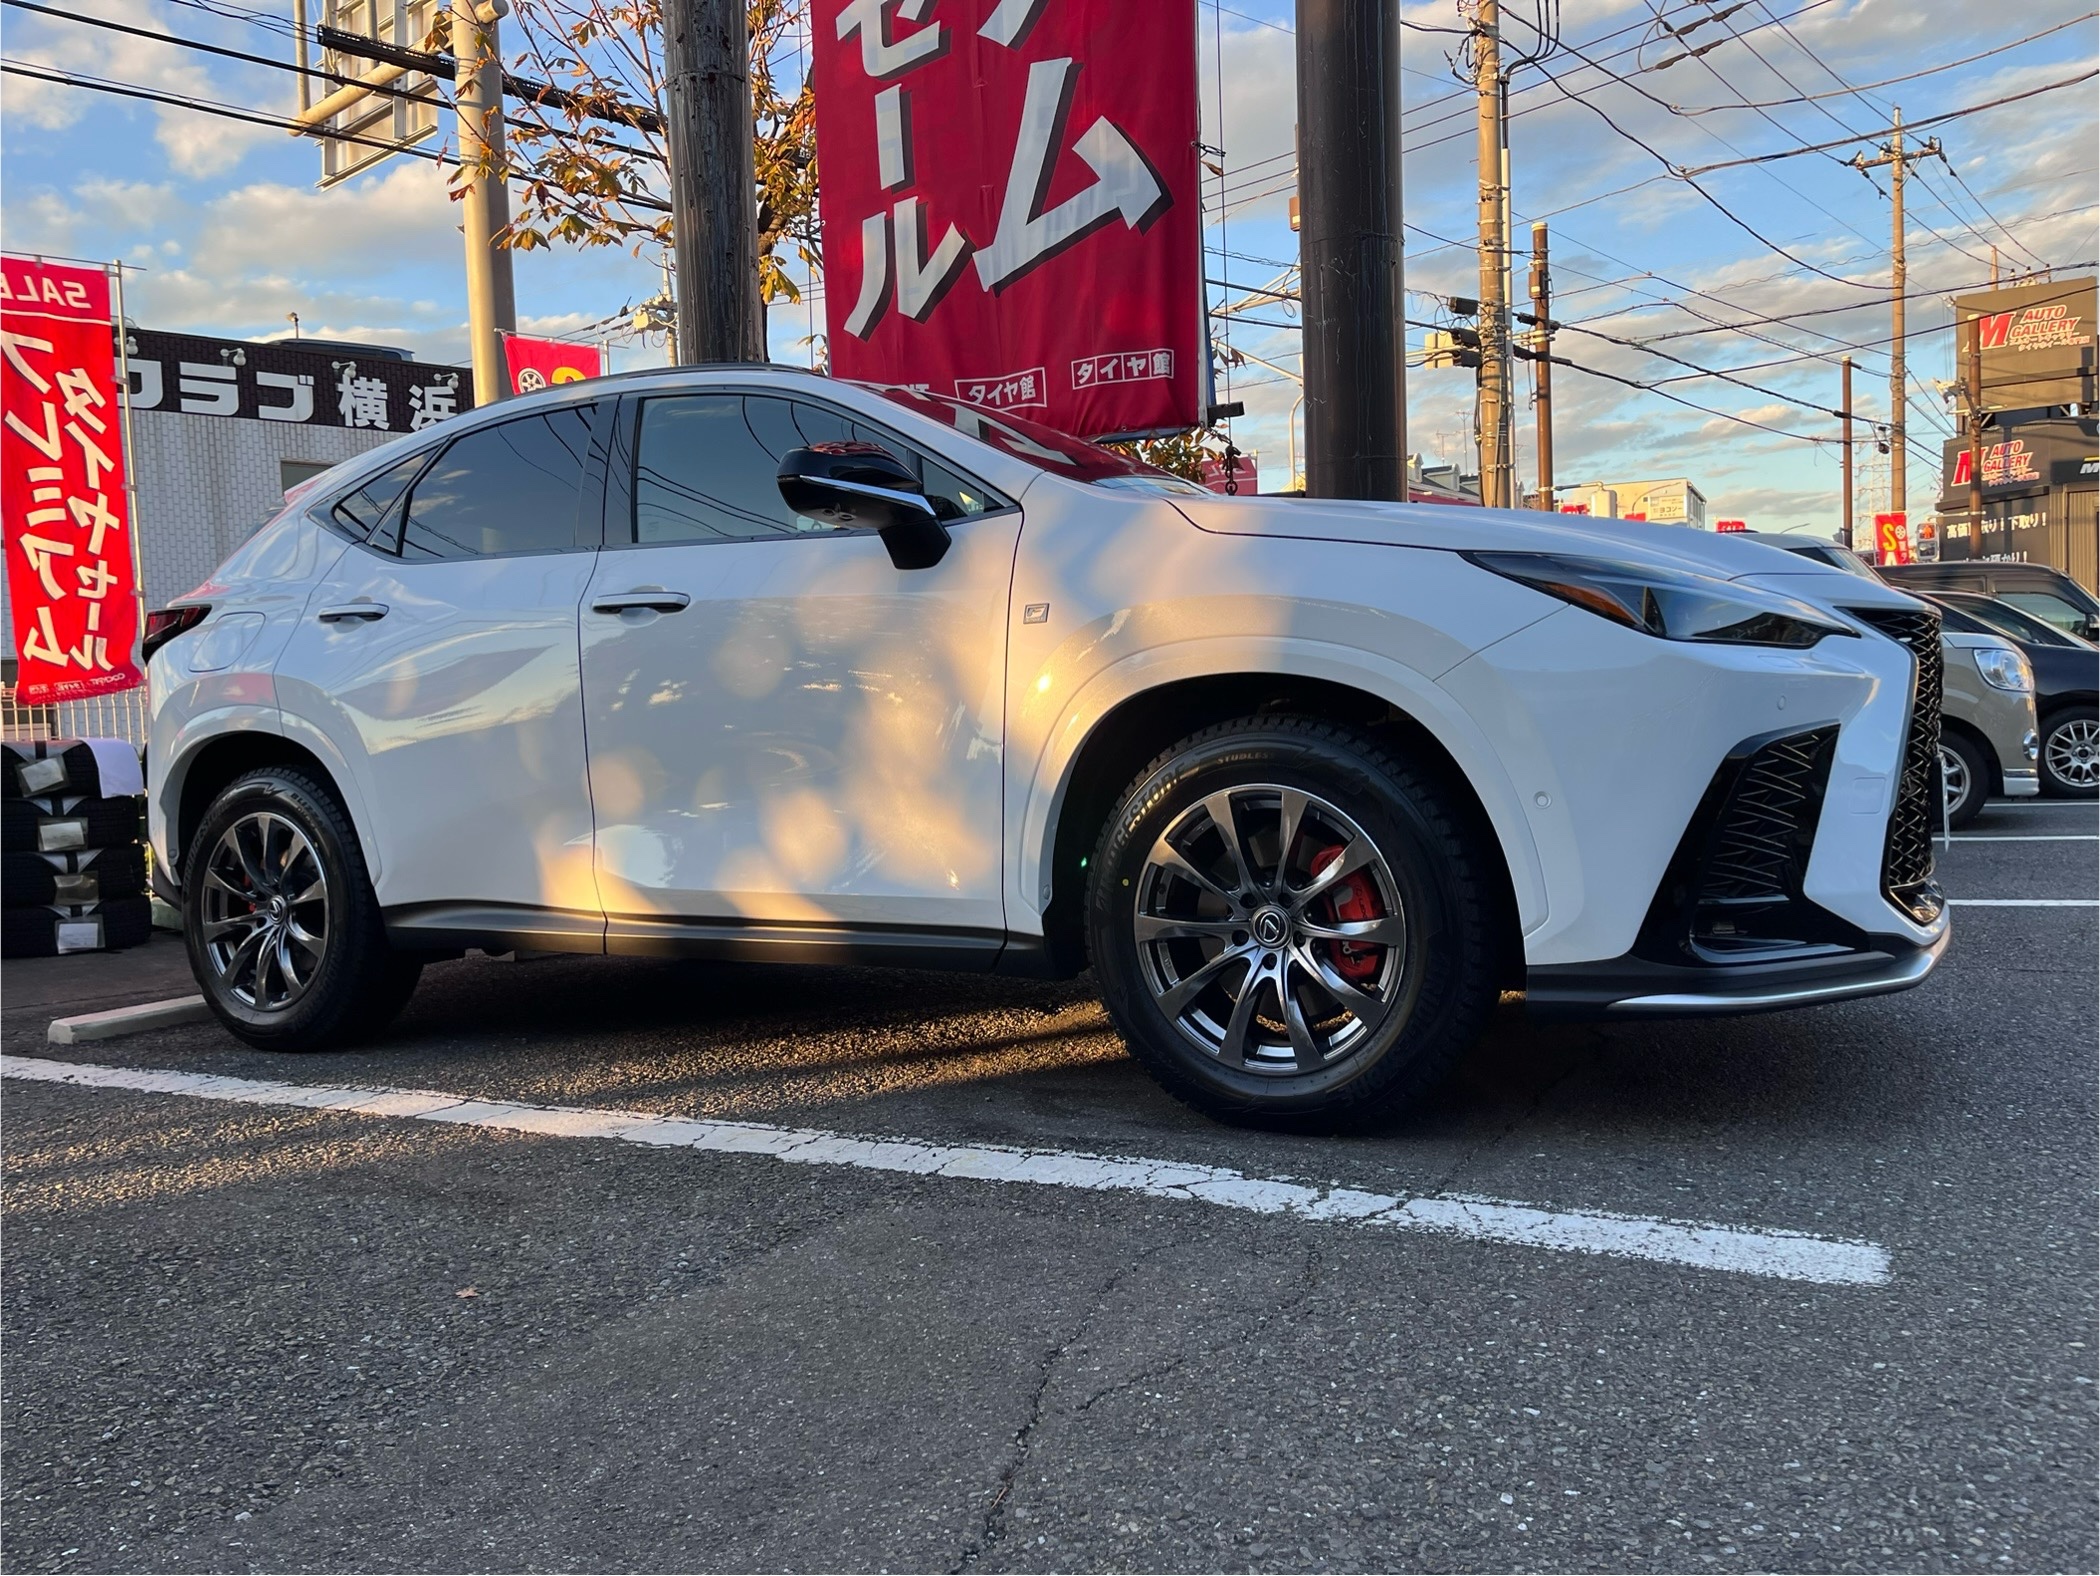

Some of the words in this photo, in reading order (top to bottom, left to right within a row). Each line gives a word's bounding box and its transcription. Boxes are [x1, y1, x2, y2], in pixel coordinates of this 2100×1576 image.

[2020, 305, 2067, 324] AUTO
[2009, 317, 2081, 339] GALLERY
[1076, 352, 1170, 384] タイヤ館
[968, 375, 1036, 405] タイヤ館
[1989, 440, 2023, 459] AUTO
[1982, 452, 2033, 473] GALLERY
